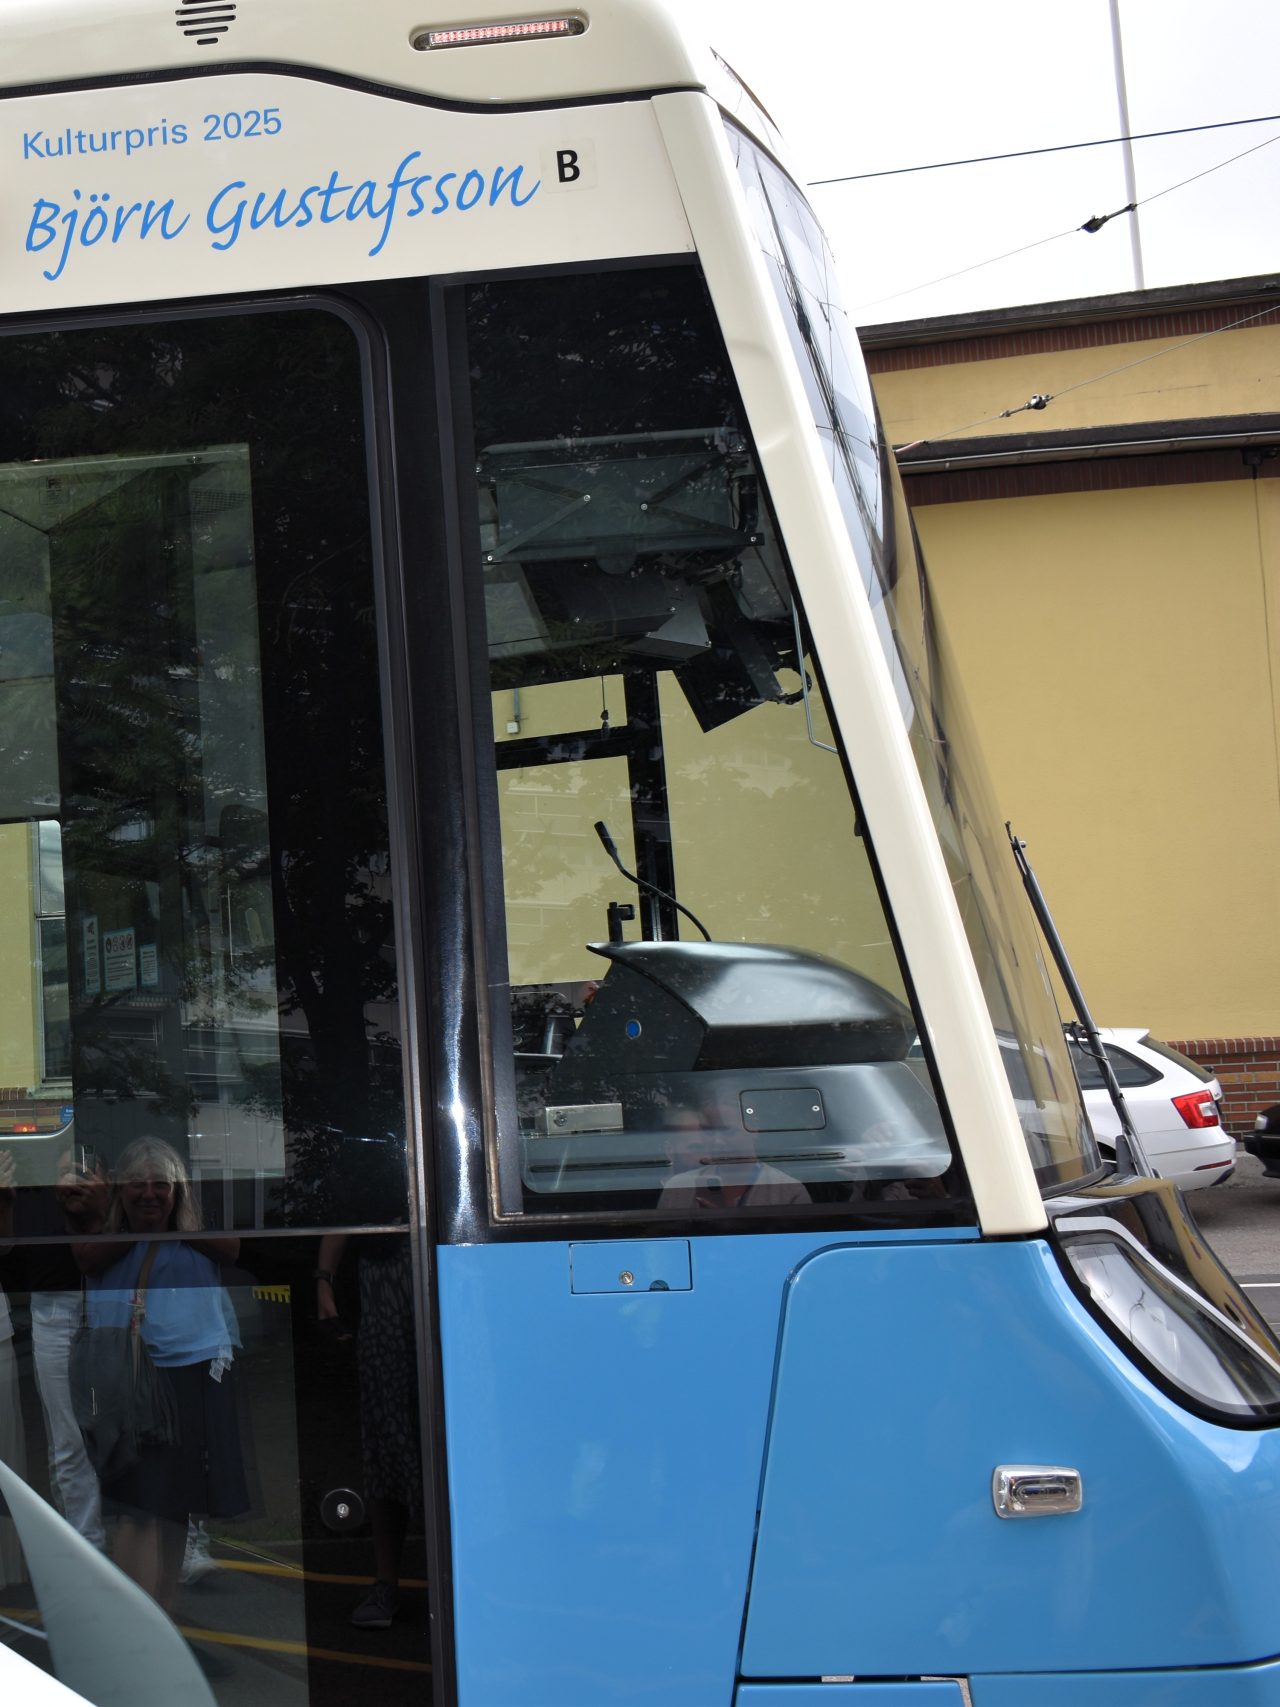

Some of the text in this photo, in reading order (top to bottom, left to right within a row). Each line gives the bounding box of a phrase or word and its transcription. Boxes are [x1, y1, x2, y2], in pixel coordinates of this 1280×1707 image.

[23, 107, 283, 160] Kulturpris 2025
[556, 149, 580, 183] B
[25, 150, 540, 281] Björn Gustafsson
